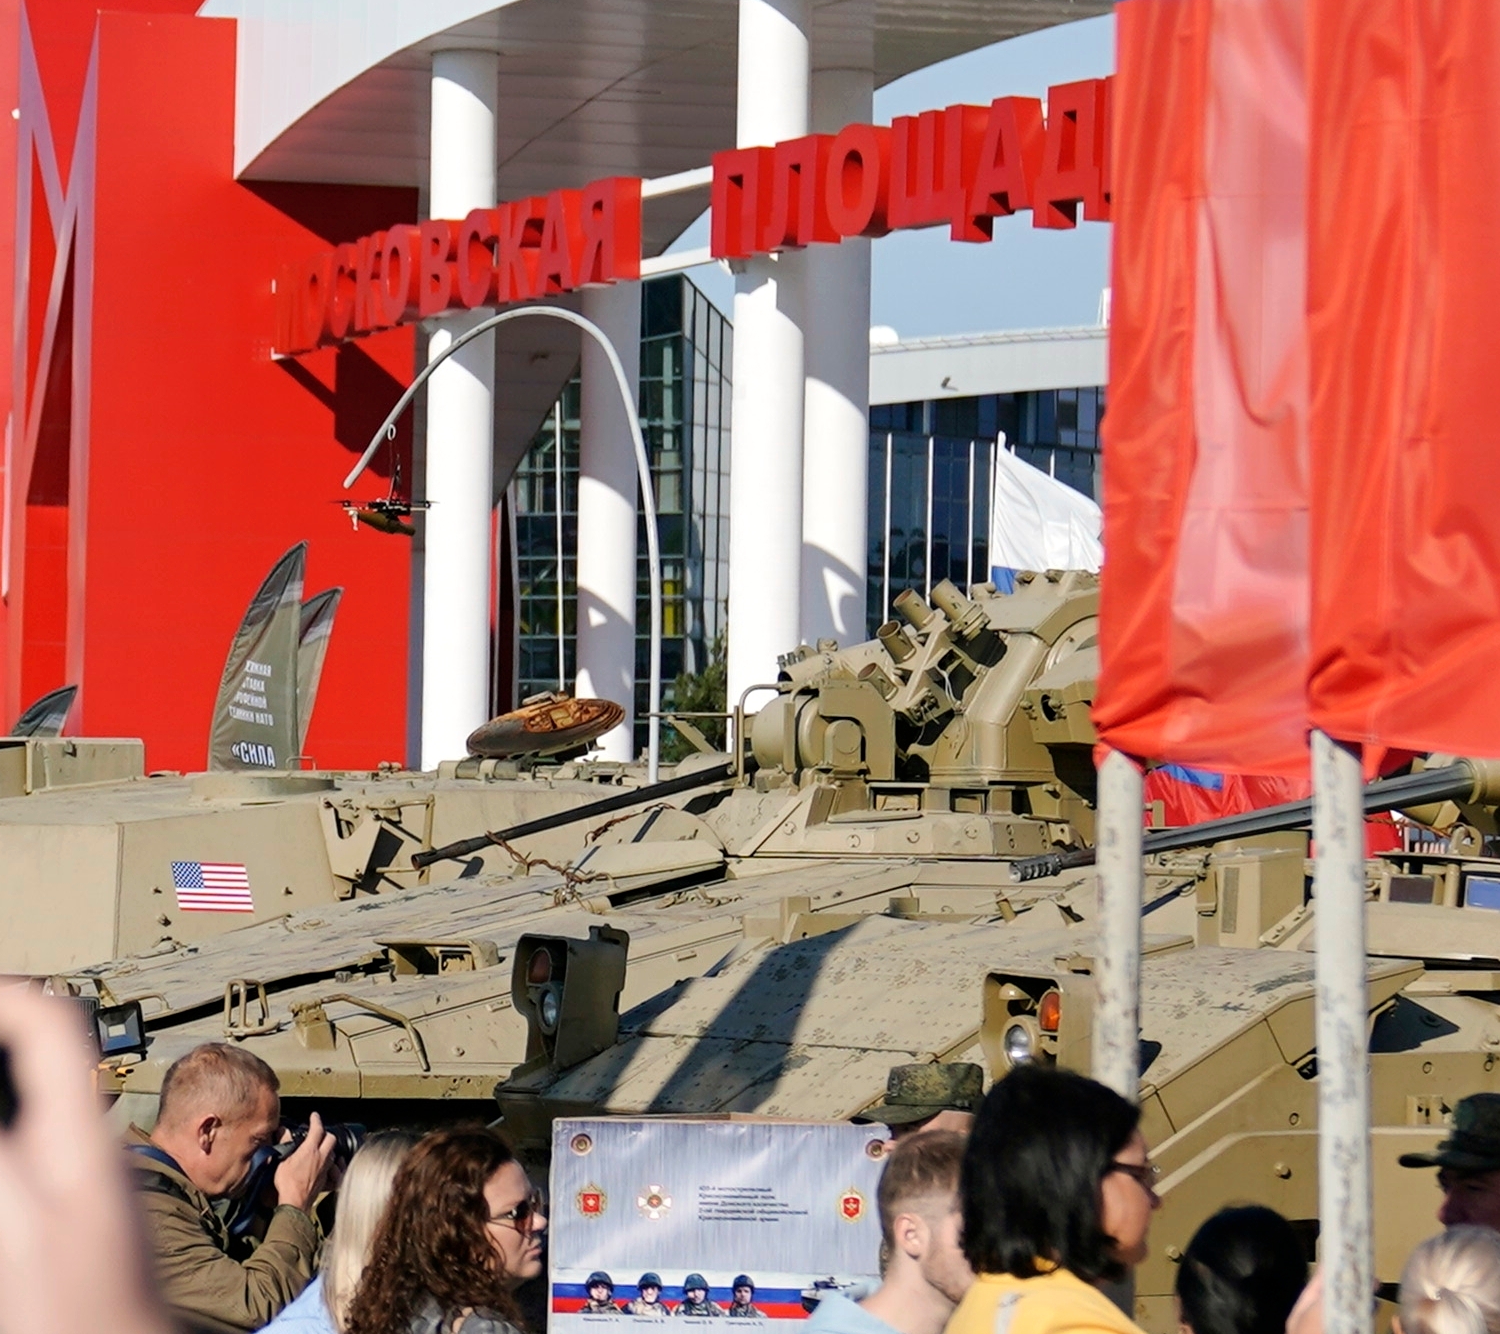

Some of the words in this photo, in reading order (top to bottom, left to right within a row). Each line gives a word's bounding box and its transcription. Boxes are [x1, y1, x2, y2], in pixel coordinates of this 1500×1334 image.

[711, 76, 1111, 259] ПЛОЩАД
[255, 711, 274, 726] НАТО
[231, 741, 276, 768] «СИЛА
